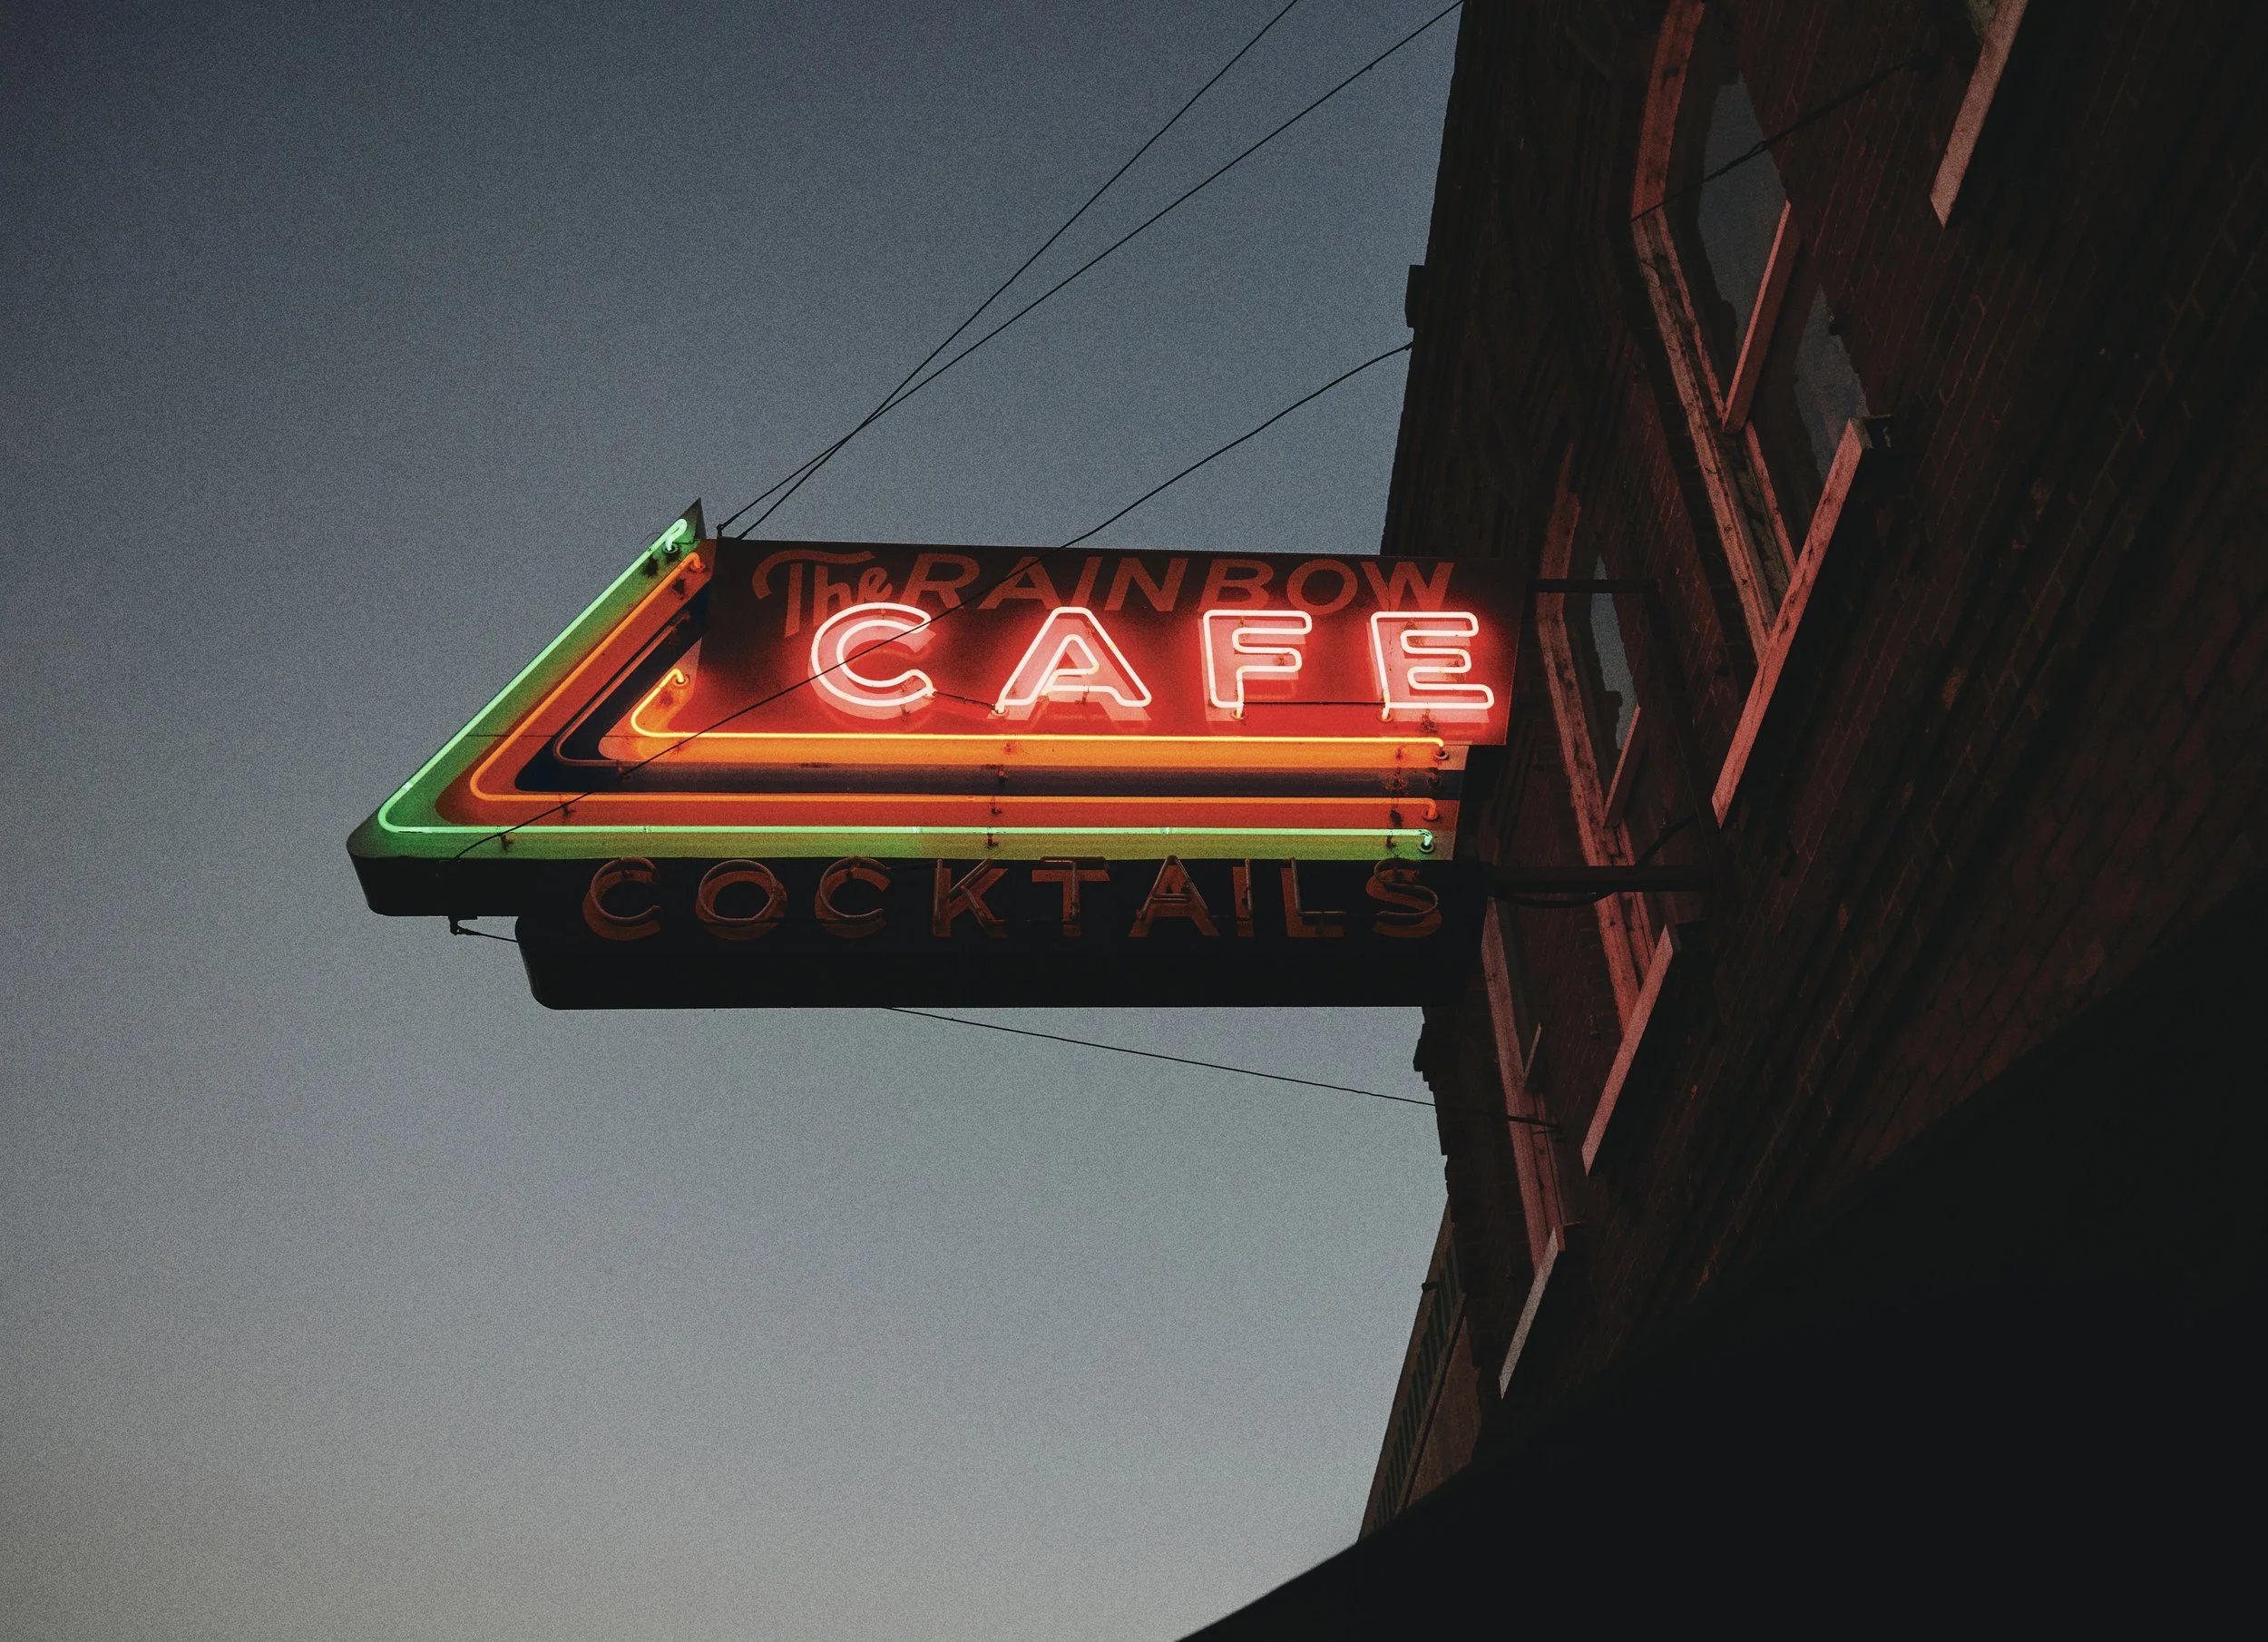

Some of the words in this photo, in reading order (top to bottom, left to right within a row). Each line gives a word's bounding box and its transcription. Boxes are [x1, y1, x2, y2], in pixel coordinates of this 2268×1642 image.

[752, 549, 894, 637] The
[899, 552, 1454, 616] RAINBOW
[808, 601, 1495, 722] CAFE
[582, 856, 1442, 941] COCKTAILS
